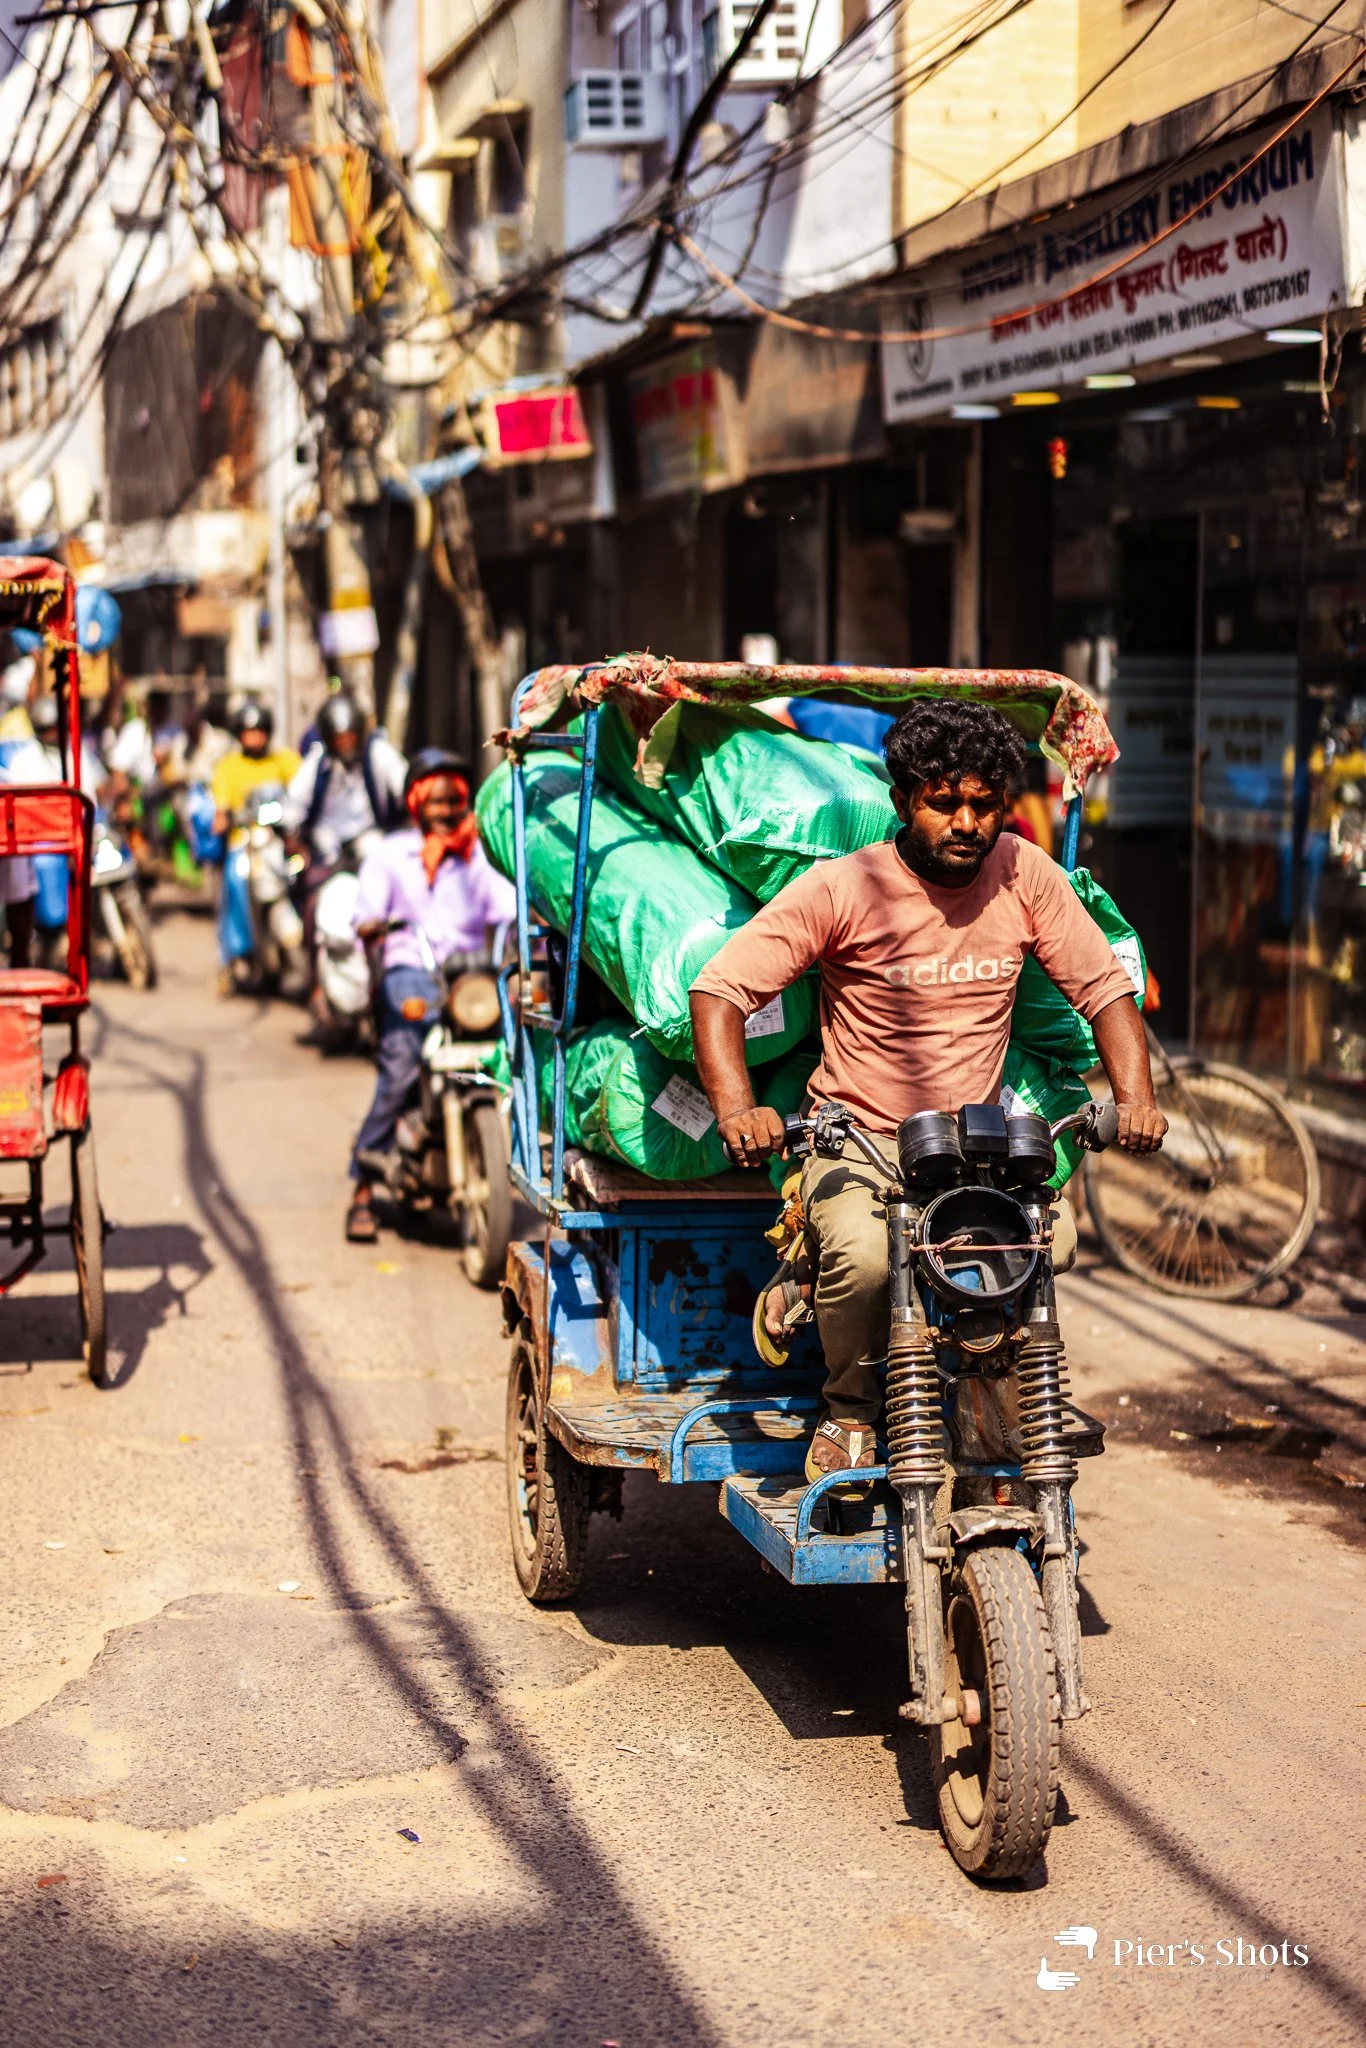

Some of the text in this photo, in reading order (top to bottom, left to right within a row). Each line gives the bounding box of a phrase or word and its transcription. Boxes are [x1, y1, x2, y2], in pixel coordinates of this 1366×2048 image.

[1168, 130, 1314, 225] EMPORIUM
[1116, 260, 1167, 315] कुमार
[1169, 241, 1230, 293] (गिलट
[1235, 214, 1288, 262] वाले)
[884, 954, 1016, 987] adidas
